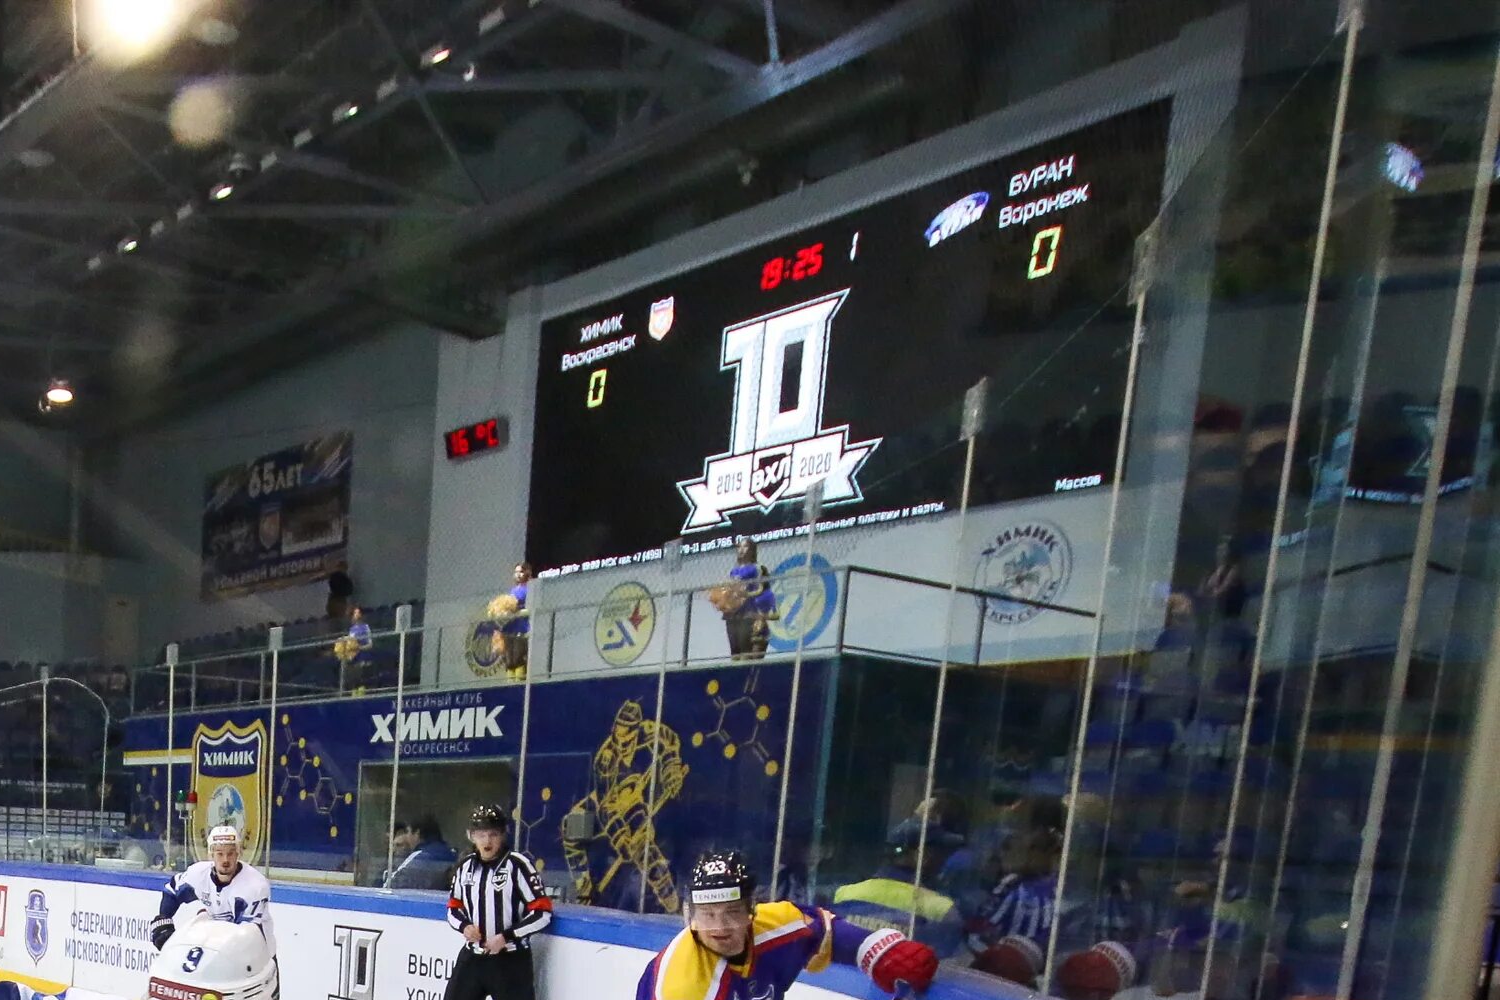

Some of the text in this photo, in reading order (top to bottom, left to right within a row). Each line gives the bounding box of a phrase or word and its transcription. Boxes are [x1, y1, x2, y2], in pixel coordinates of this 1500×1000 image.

[1009, 155, 1075, 197] БУРАН
[999, 183, 1090, 229] Воронеж
[1028, 225, 1062, 280] 0
[580, 313, 624, 343] ХИМИК
[561, 334, 637, 372] Воскресенск
[720, 288, 850, 452] 10
[586, 368, 608, 408] 0
[250, 461, 277, 498] 65
[716, 452, 833, 495] 2019 ВХЛ 2020
[795, 516, 856, 536] элетронные
[391, 692, 483, 710] ХККЕЙНЫЙ КЛУБ
[369, 705, 506, 743] ХИМИК
[203, 750, 255, 767] ХИМИК
[70, 911, 123, 938] ФЕДЕРАЦИЯ
[64, 937, 122, 968] МОСКОВСКОЙ
[182, 946, 204, 974] 9
